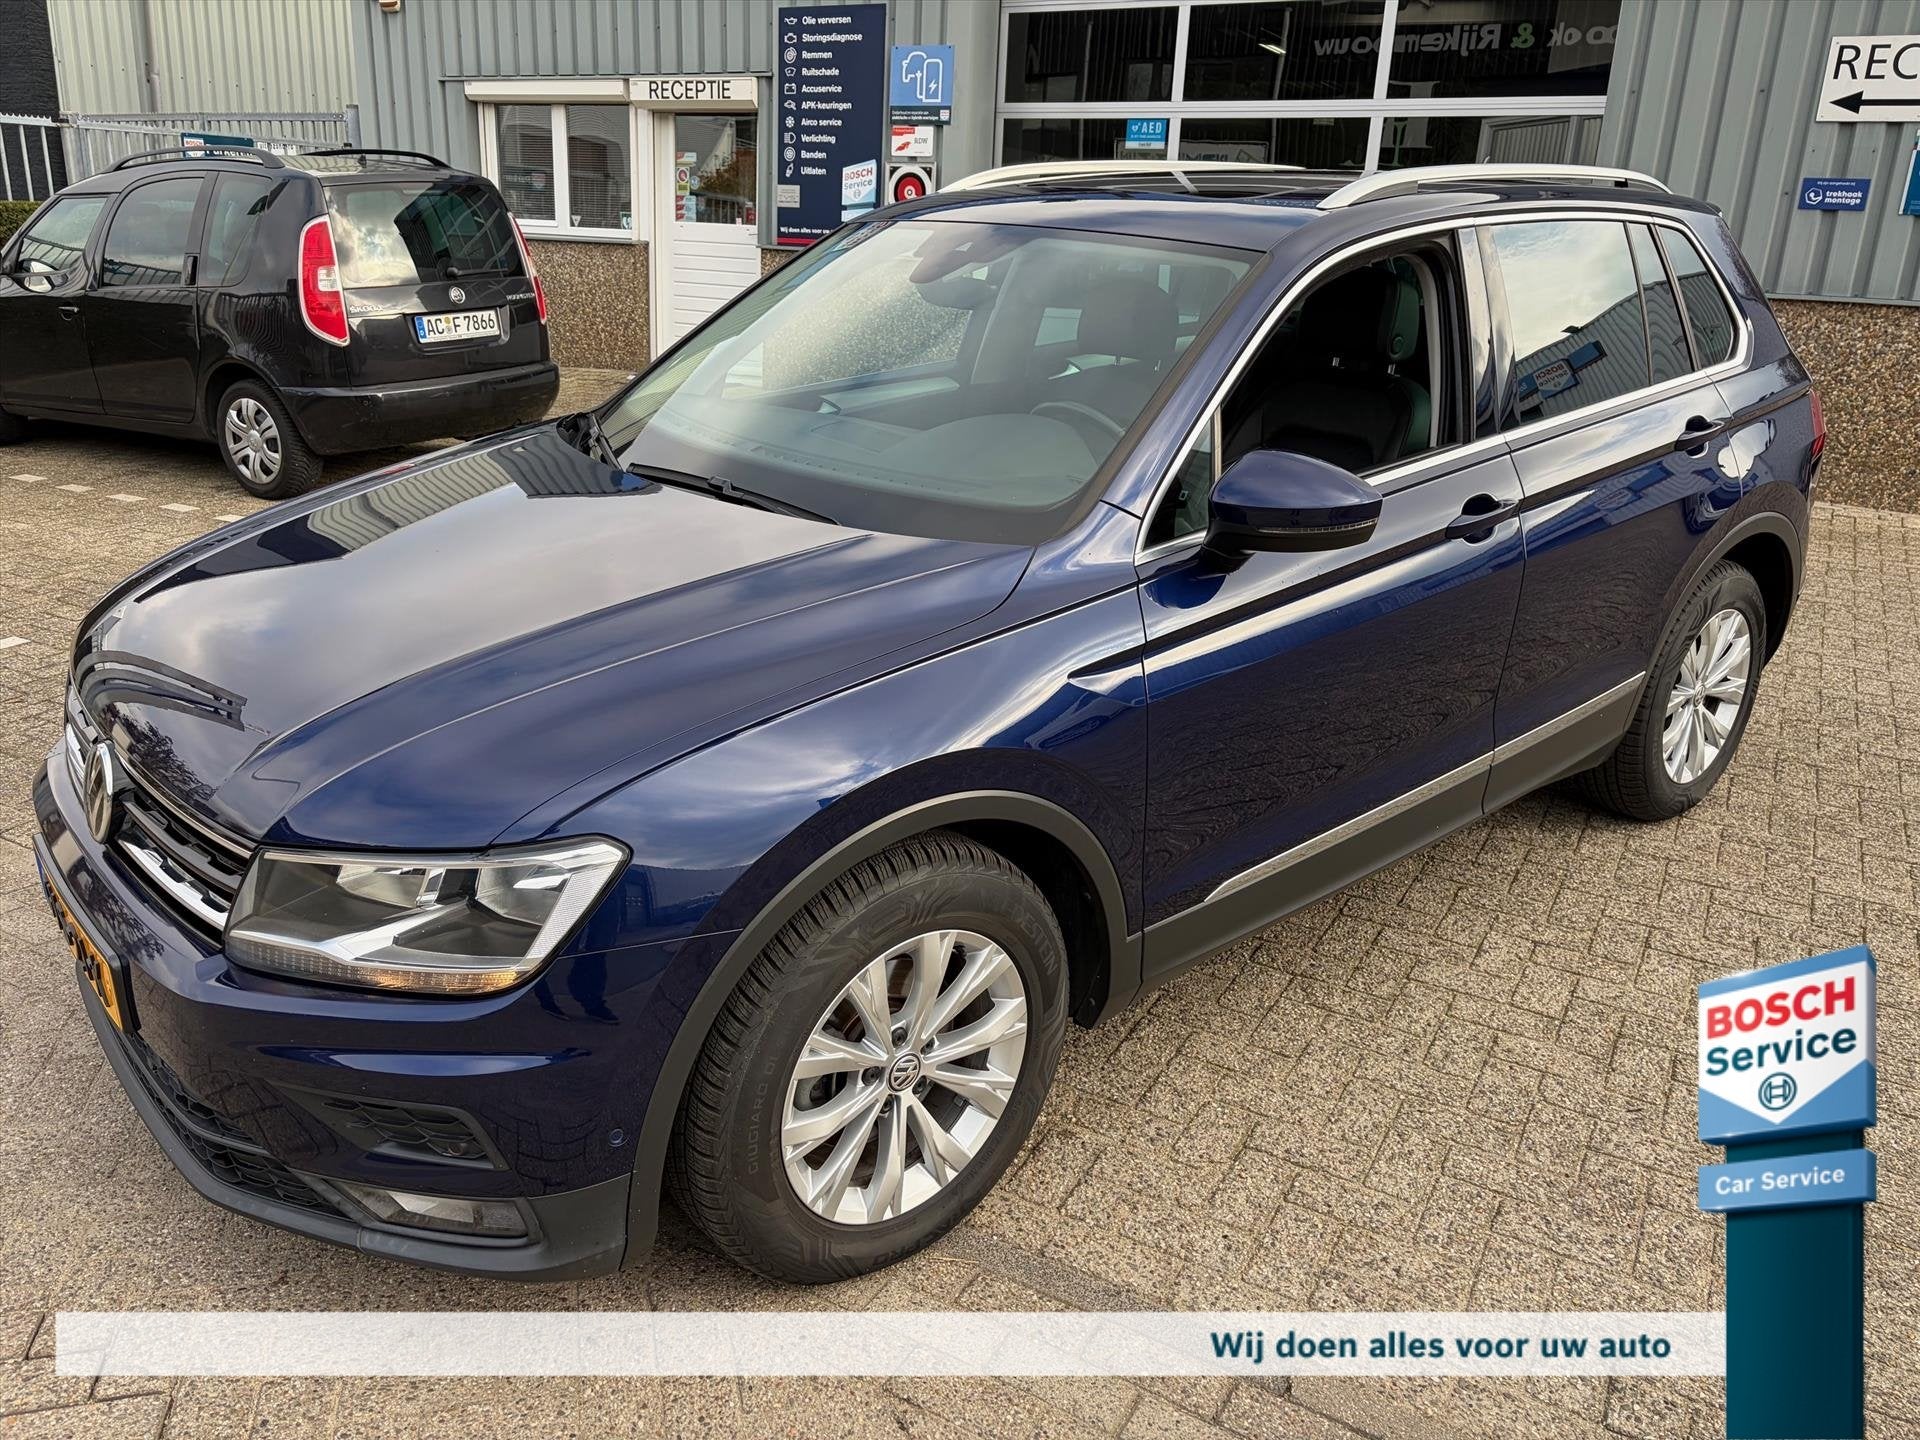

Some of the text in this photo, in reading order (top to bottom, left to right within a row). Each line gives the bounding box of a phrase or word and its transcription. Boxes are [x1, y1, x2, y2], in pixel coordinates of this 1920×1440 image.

[802, 16, 851, 25] Olie verversen
[802, 33, 863, 43] Storingsdiagnose
[802, 51, 832, 59] Remmen
[1832, 43, 1920, 80] REC
[802, 68, 839, 76] Ruitschade
[649, 80, 731, 100] RECEPTIE
[801, 84, 842, 93] Accuservice
[801, 101, 852, 110] APK-keuringen
[801, 118, 842, 126] Airco service
[1141, 122, 1162, 134] AED
[801, 132, 836, 144] Verlichting
[801, 151, 826, 159] Banden
[801, 167, 827, 175] Uitlaten
[844, 167, 873, 181] BOSCH
[844, 179, 873, 190] Service
[427, 318, 445, 336] AC
[464, 313, 496, 332] 7866
